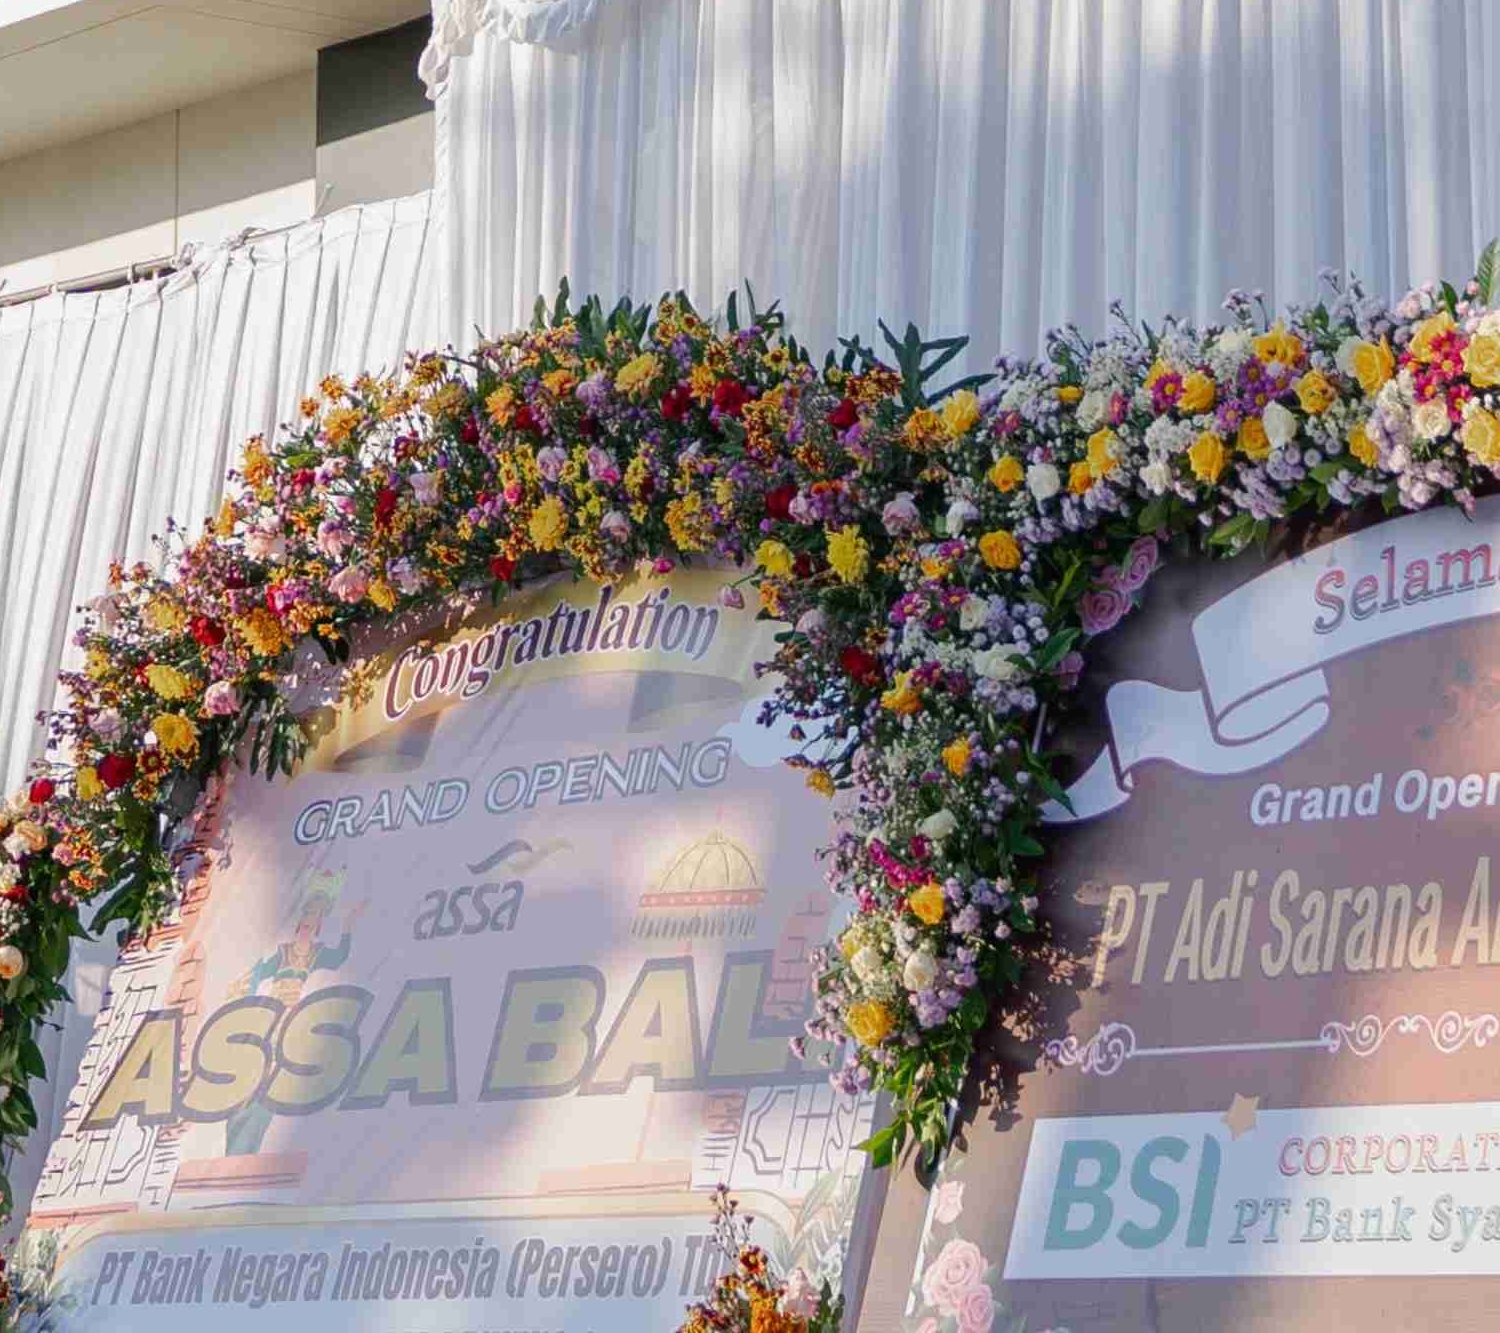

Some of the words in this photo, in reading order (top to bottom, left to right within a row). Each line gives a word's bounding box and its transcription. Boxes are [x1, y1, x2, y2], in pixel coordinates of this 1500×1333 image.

[384, 583, 720, 721] Congratulation
[293, 776, 470, 846] GRAND
[483, 737, 733, 814] OPENING
[1249, 772, 1382, 826] Grand
[412, 879, 525, 941] assa
[1092, 881, 1171, 989] PT
[1163, 869, 1258, 984] Adi
[1258, 869, 1440, 979] Sarana
[80, 978, 458, 1131] ASSA
[1043, 1132, 1223, 1252] BSI
[1226, 1196, 1292, 1245] PT
[1300, 1196, 1417, 1243] Bank
[91, 1250, 135, 1306] PT
[130, 1249, 203, 1306] Bank
[210, 1245, 325, 1309] Negara
[330, 1237, 500, 1300] Indonesia
[502, 1237, 672, 1300] (Persero)
[678, 1235, 732, 1297] Tb
